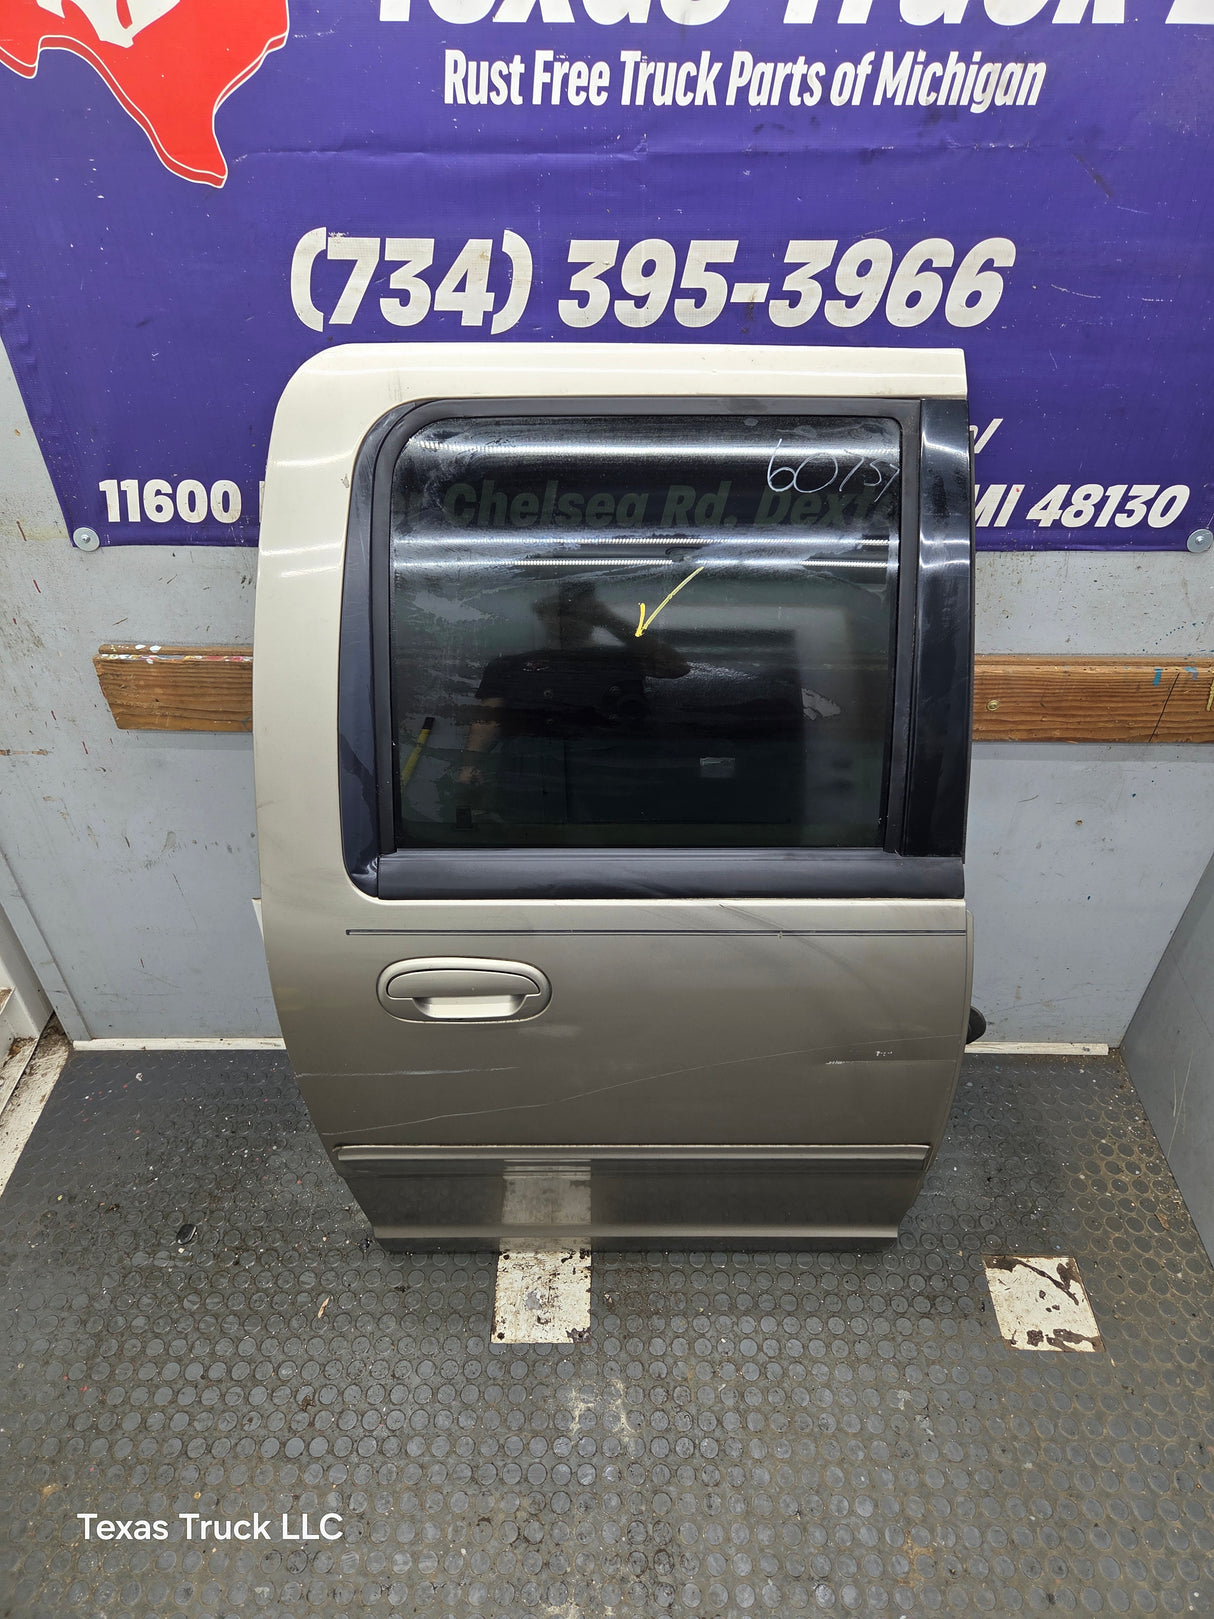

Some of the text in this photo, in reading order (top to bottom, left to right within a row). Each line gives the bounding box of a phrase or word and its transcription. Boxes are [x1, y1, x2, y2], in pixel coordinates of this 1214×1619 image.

[444, 49, 1047, 114] Rust Free Truck Parts of Michigan
[290, 226, 1018, 335] (734) 395-3966
[98, 478, 242, 524] 11600
[443, 479, 649, 527] Chelsea
[660, 480, 738, 528] Rd.
[1025, 483, 1191, 528] 48130
